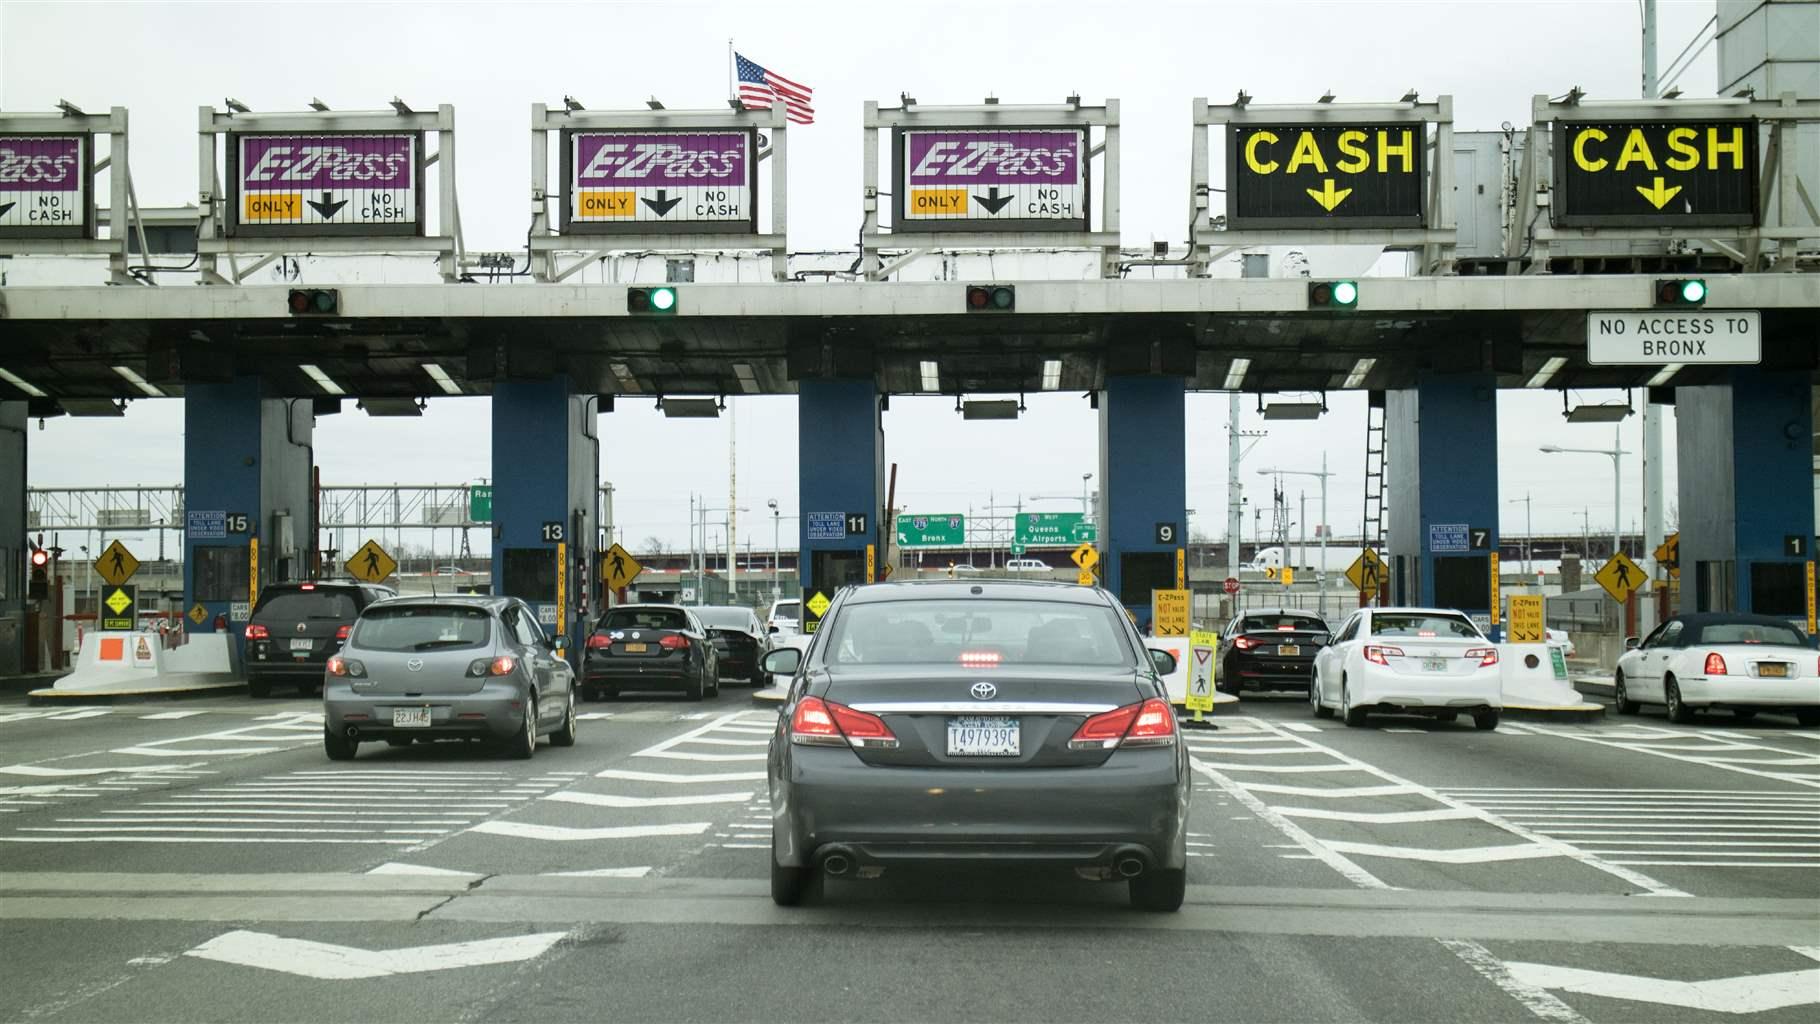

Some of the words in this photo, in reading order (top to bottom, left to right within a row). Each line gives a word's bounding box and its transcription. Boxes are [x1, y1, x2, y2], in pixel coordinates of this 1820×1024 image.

[1245, 131, 1413, 175] CASH
[1573, 127, 1744, 172] CASH
[245, 147, 407, 181] E-ZPass
[580, 144, 741, 178] E-ZPass
[911, 141, 1074, 176] E-ZPass
[372, 194, 391, 204] NO
[705, 191, 726, 202] NO
[1038, 189, 1058, 200] NO
[39, 196, 59, 207] NO
[252, 201, 294, 212] ONLY
[585, 198, 628, 209] ONLY
[918, 196, 960, 207] ONLY
[362, 207, 404, 218] CASH
[695, 205, 738, 216] CASH
[1028, 203, 1071, 214] CASH
[29, 210, 72, 221] CASH
[1600, 319, 1625, 335] NO
[1637, 319, 1714, 335] ACCESS
[1726, 319, 1749, 334] TO
[1643, 340, 1706, 356] BRONX
[227, 516, 248, 531] 15
[848, 517, 865, 532] 11
[543, 525, 563, 540] 13
[1028, 526, 1059, 534] Queens
[1160, 526, 1172, 542] 9
[921, 534, 946, 542] Bronx
[1032, 535, 1067, 543] Airports
[1474, 532, 1486, 547] 7
[1791, 538, 1800, 553] 1
[1158, 603, 1171, 612] NOT
[1513, 608, 1526, 620] NOT
[952, 729, 1015, 746] T497939C
